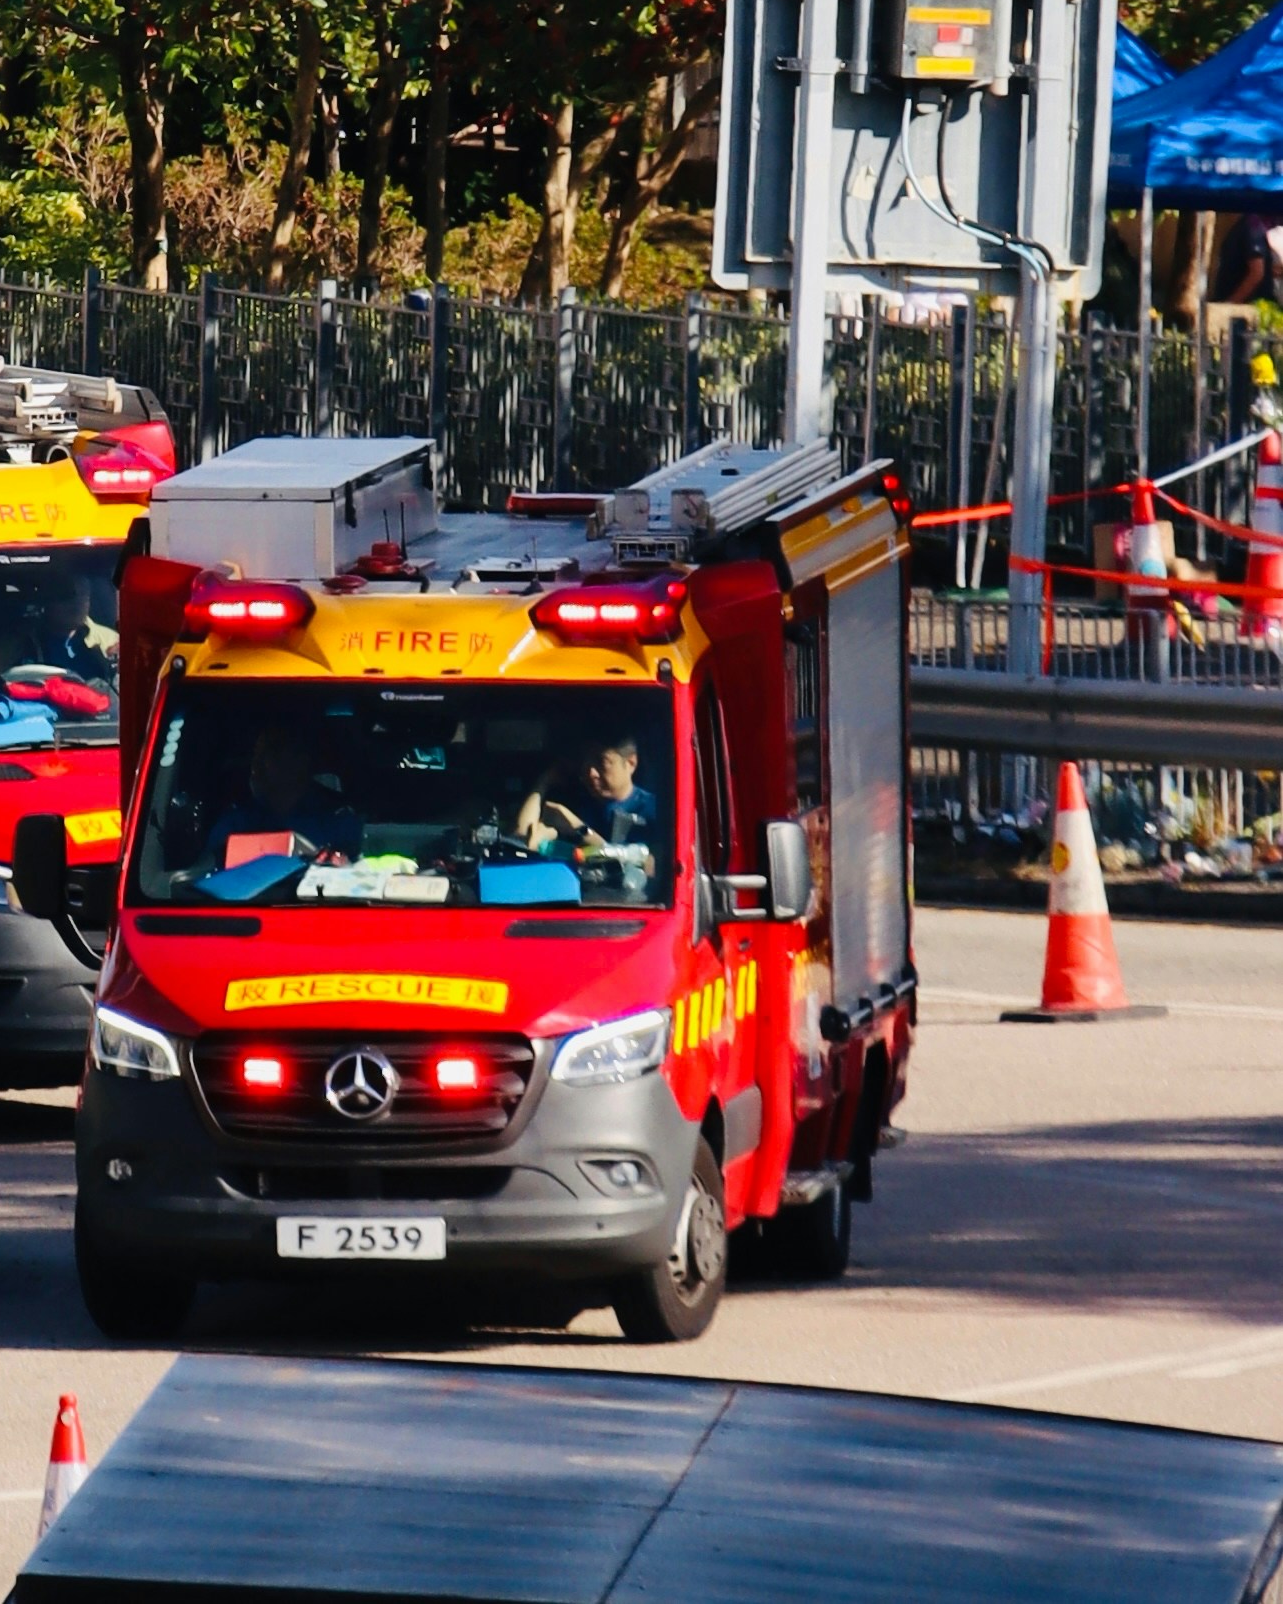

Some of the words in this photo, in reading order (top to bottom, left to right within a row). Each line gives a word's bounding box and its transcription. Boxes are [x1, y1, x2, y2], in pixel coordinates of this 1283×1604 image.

[339, 631, 364, 652] 消
[374, 631, 460, 653] FIRE
[469, 632, 495, 653] 防
[278, 977, 451, 1000] RESCUE
[297, 1225, 317, 1250] F
[335, 1226, 422, 1252] 2539
